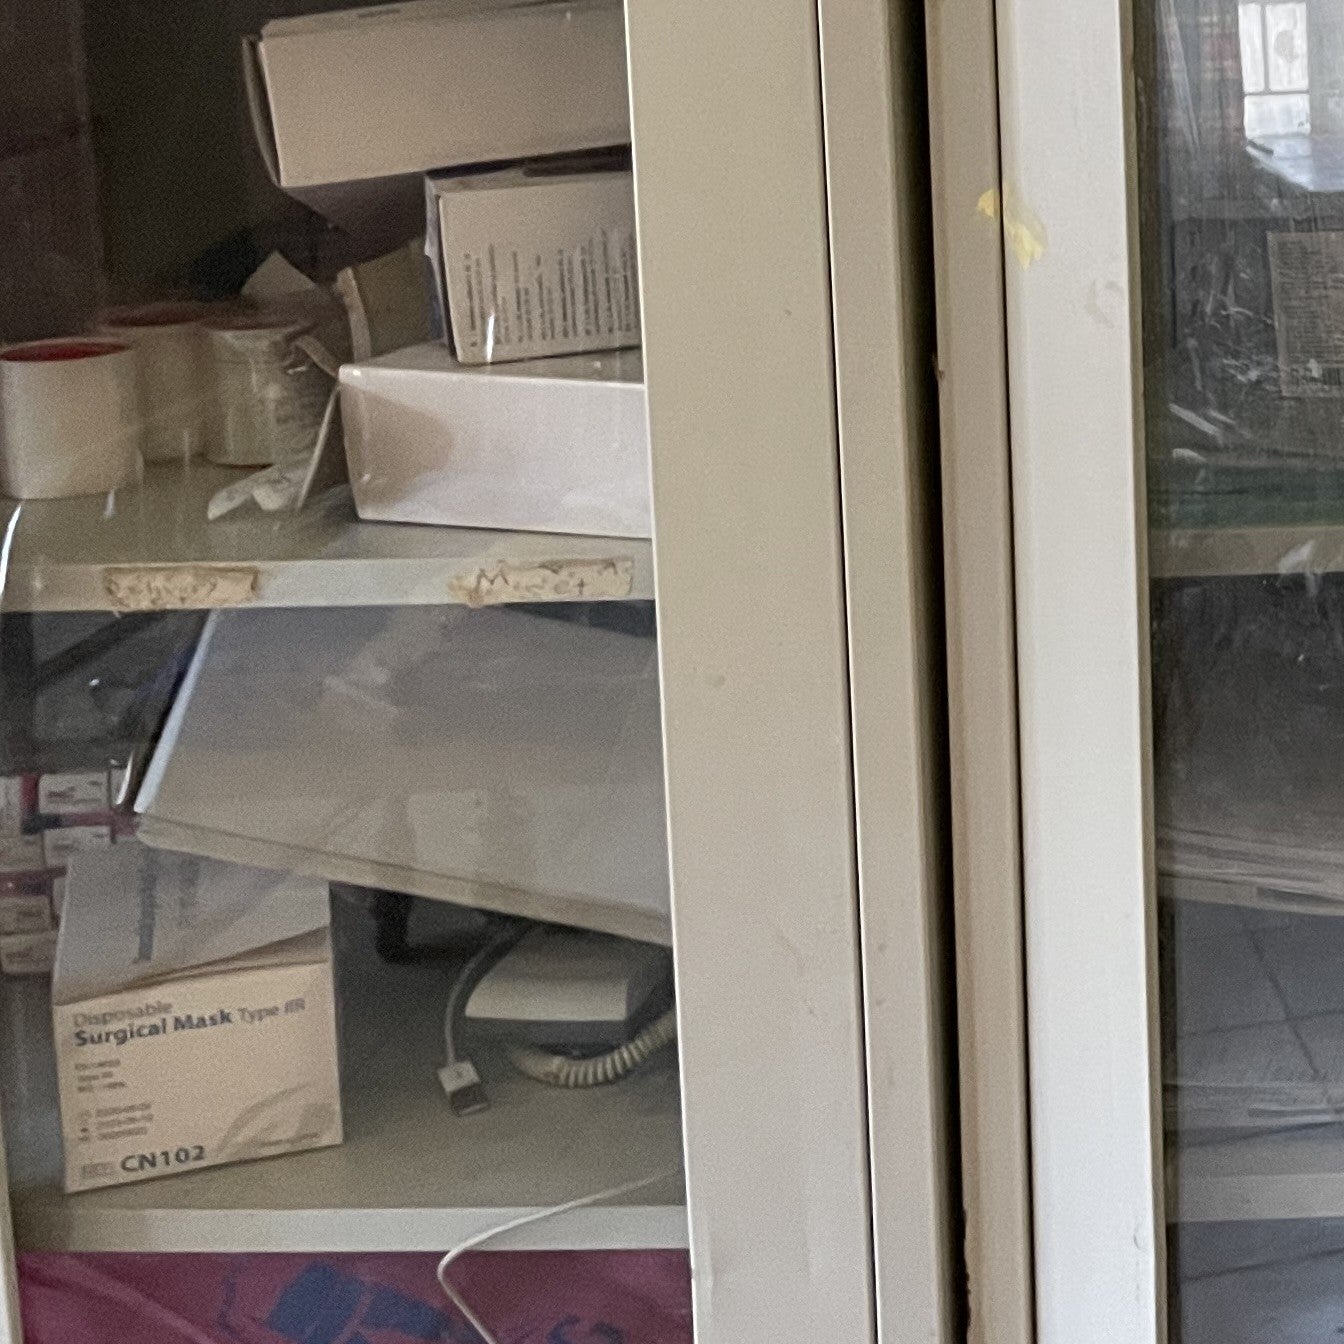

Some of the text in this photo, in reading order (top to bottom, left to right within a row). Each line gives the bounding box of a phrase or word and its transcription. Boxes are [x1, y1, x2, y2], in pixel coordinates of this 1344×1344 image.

[74, 1017, 167, 1047] Surgical
[173, 1009, 233, 1032] Mask
[238, 1005, 280, 1025] Type
[120, 1145, 206, 1173] CN102
